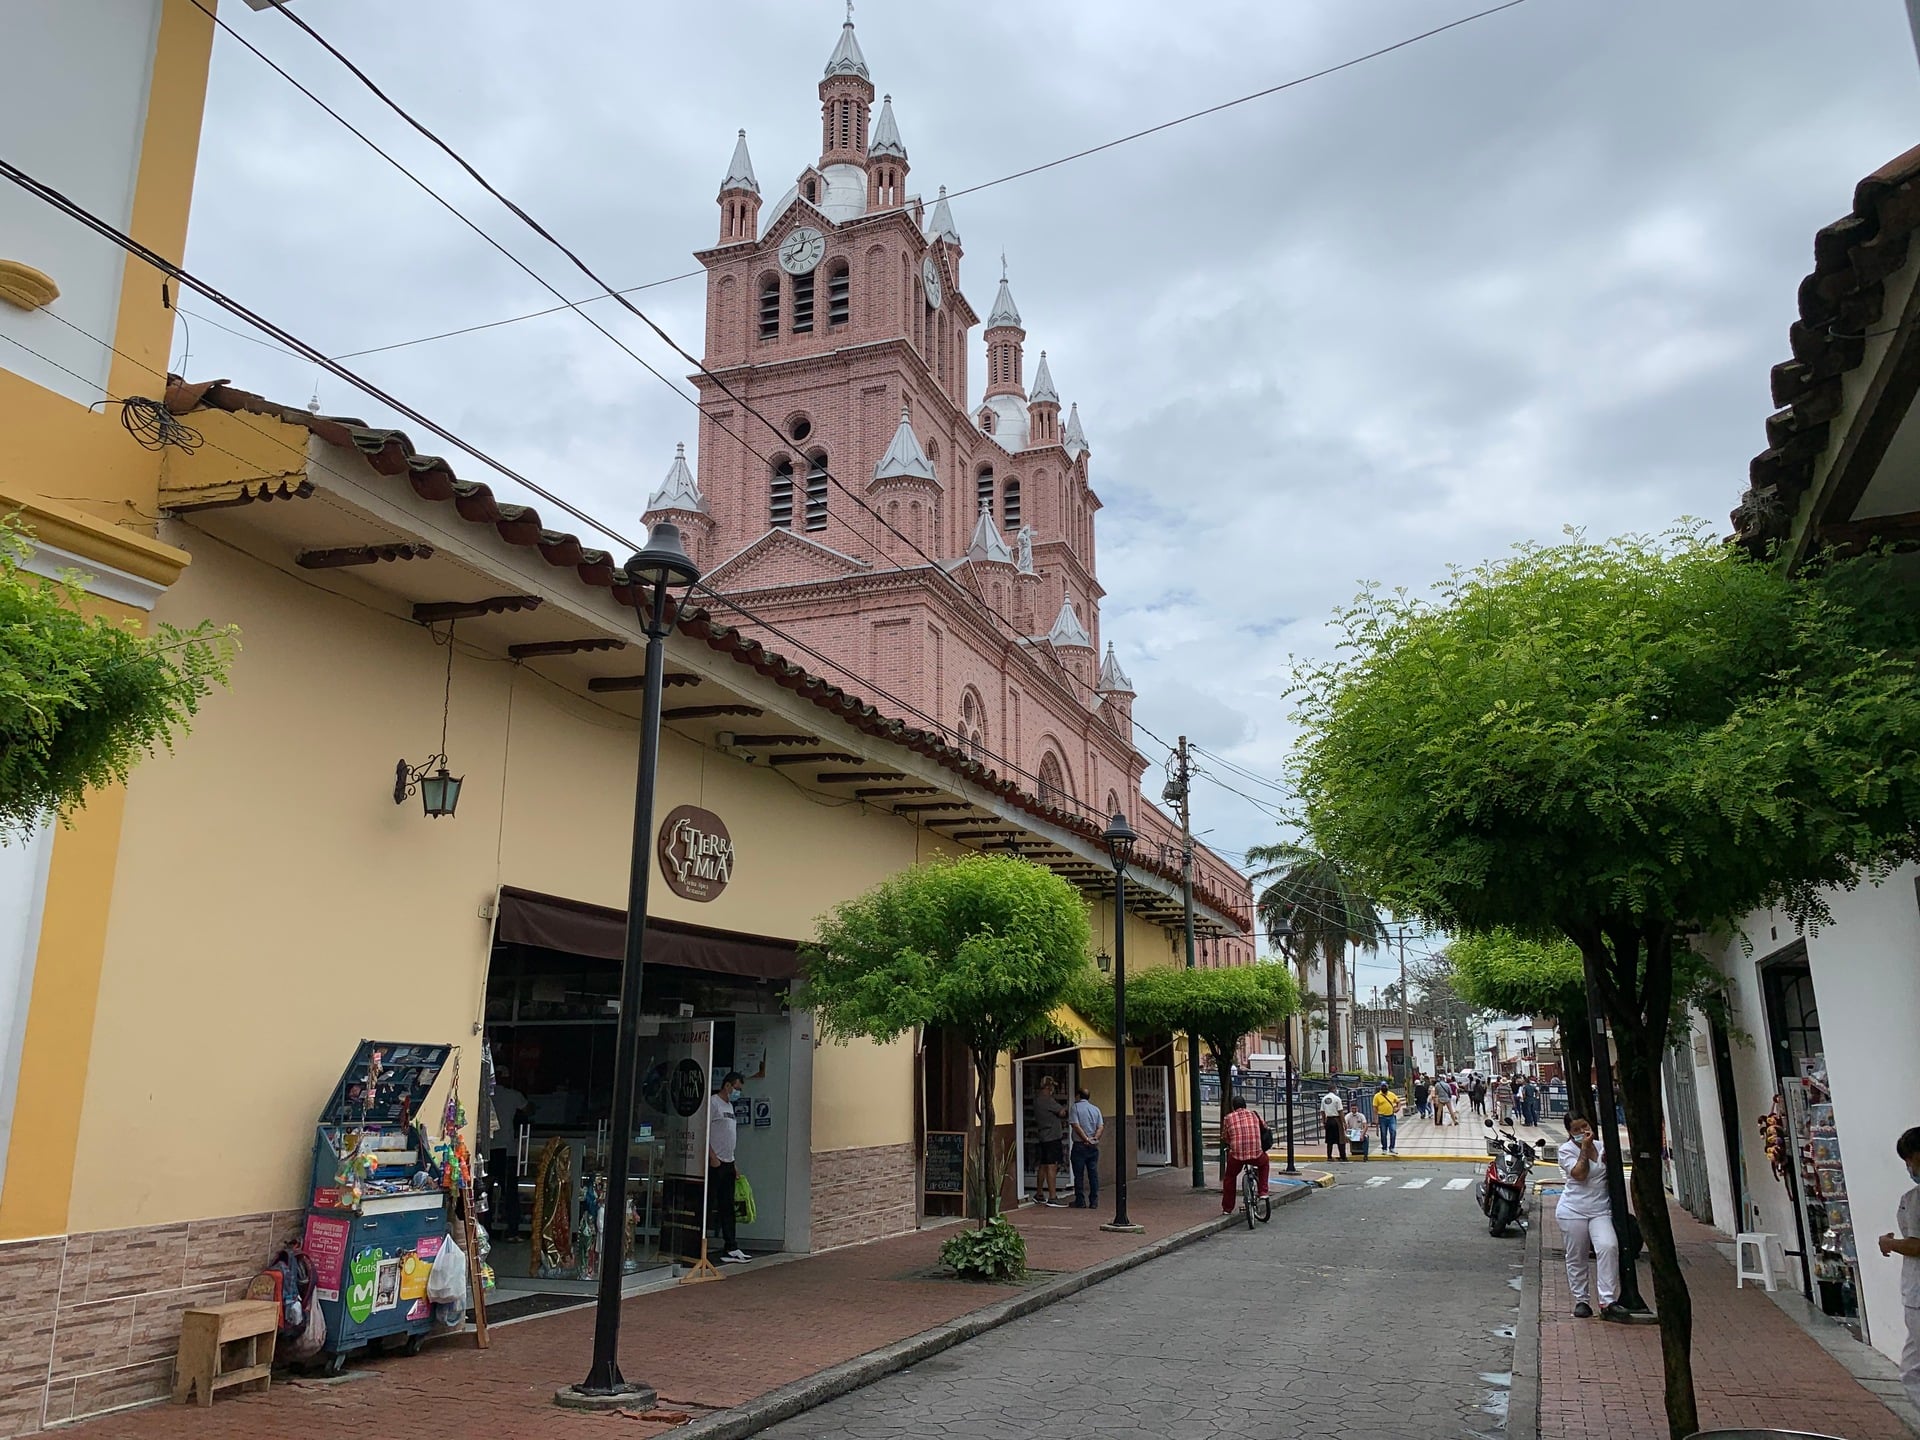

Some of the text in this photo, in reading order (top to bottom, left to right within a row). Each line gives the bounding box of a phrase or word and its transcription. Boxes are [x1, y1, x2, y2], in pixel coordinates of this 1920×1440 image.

[686, 827, 735, 860] TIERRA
[694, 855, 729, 883] MIA
[356, 1262, 377, 1274] Gratis
